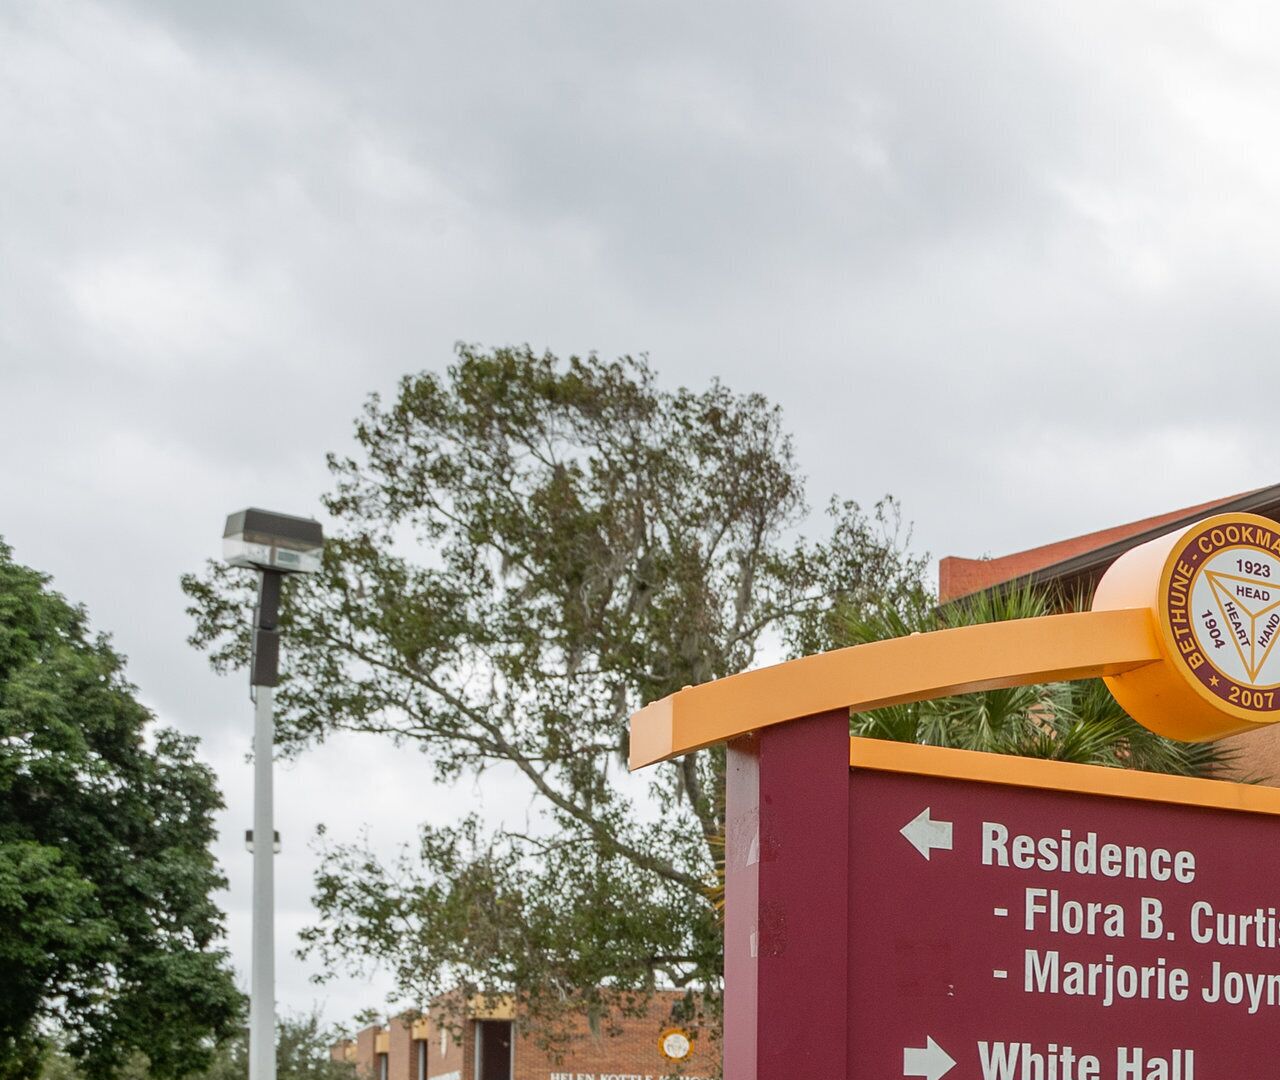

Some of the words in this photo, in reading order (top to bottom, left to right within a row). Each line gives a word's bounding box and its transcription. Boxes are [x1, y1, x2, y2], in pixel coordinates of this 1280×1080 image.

[1235, 558, 1271, 578] 1923
[1235, 585, 1270, 602] HEAD
[1200, 608, 1226, 650] 1904
[1223, 601, 1252, 648] HEART
[1257, 612, 1280, 648] HAND
[1228, 685, 1275, 709] 2007
[981, 821, 1196, 885] Residence
[1025, 887, 1125, 938] Flora
[1140, 896, 1176, 942] B.
[1024, 948, 1189, 1007] Marjorie
